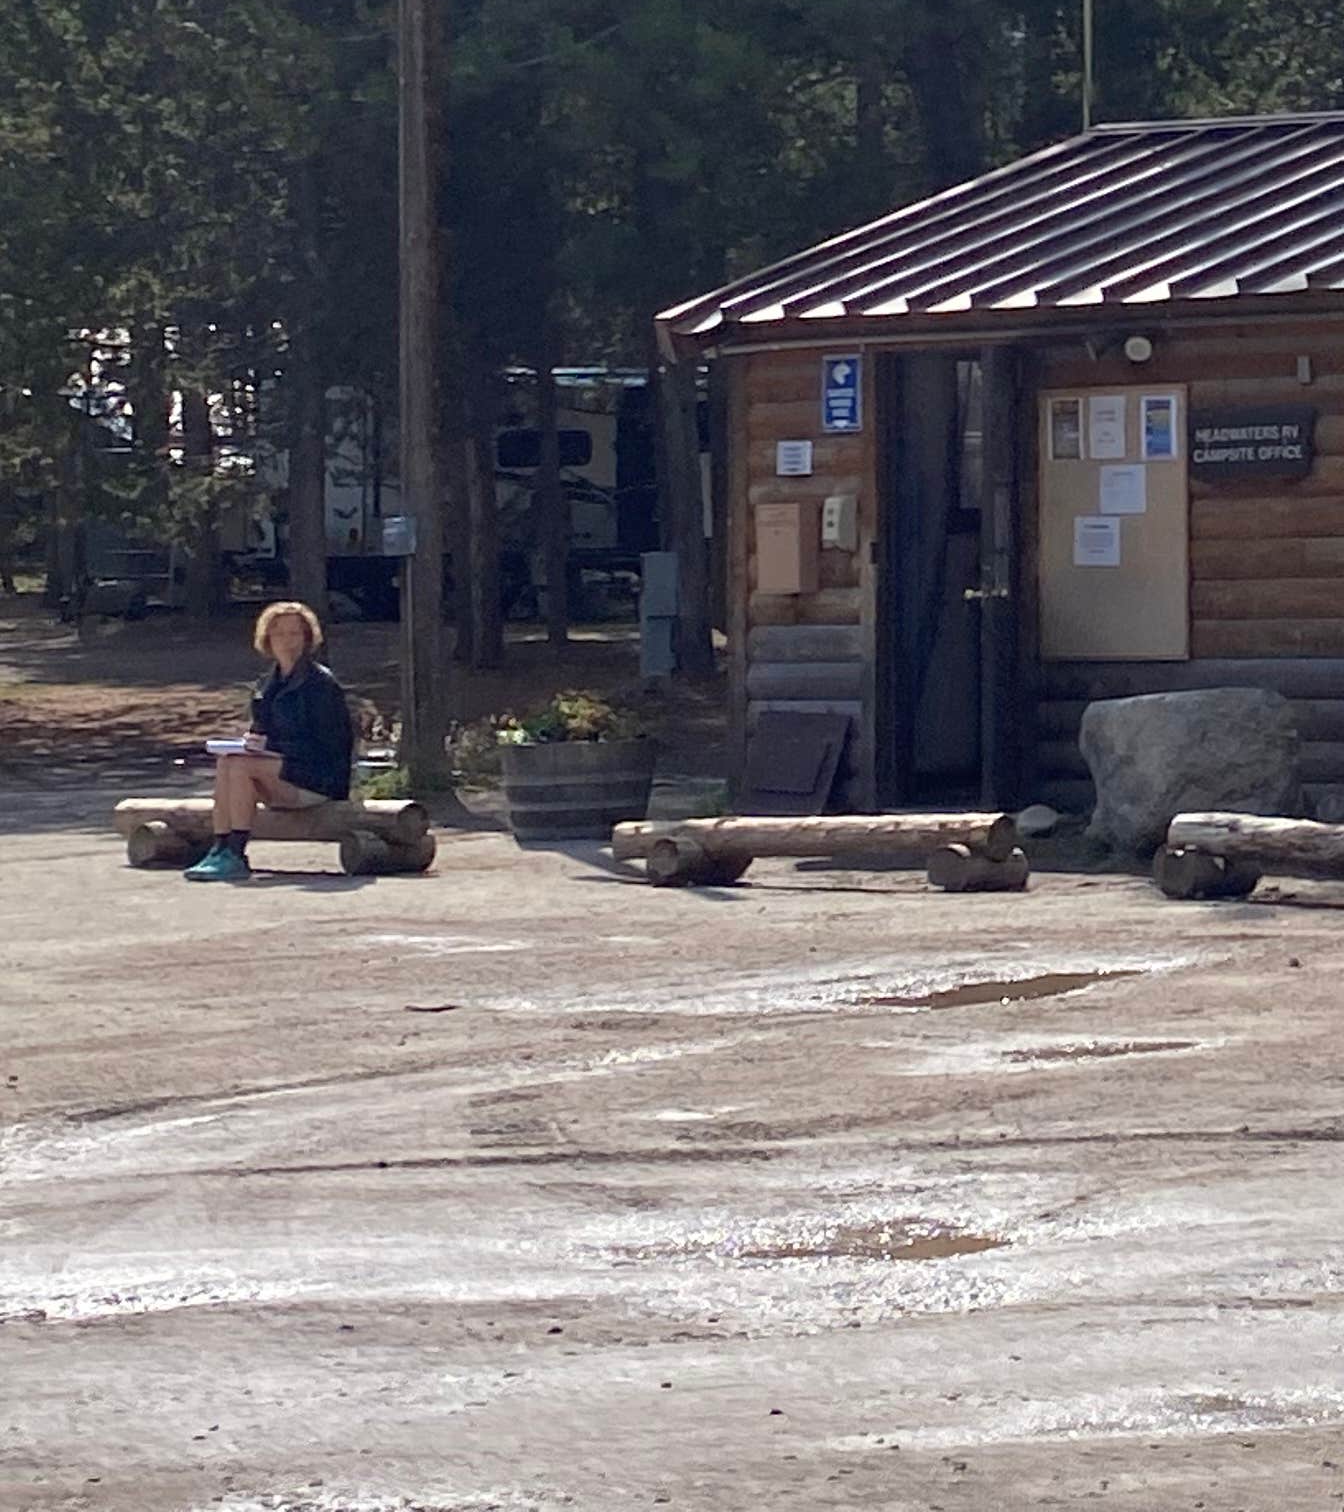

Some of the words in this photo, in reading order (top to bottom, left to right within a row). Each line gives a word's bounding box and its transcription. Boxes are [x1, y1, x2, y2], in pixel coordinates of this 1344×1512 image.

[1194, 425, 1279, 443] HEADWATERS
[1282, 425, 1299, 439] RV
[1192, 446, 1256, 464] CAMPSITE
[1257, 444, 1303, 461] OFFICE
